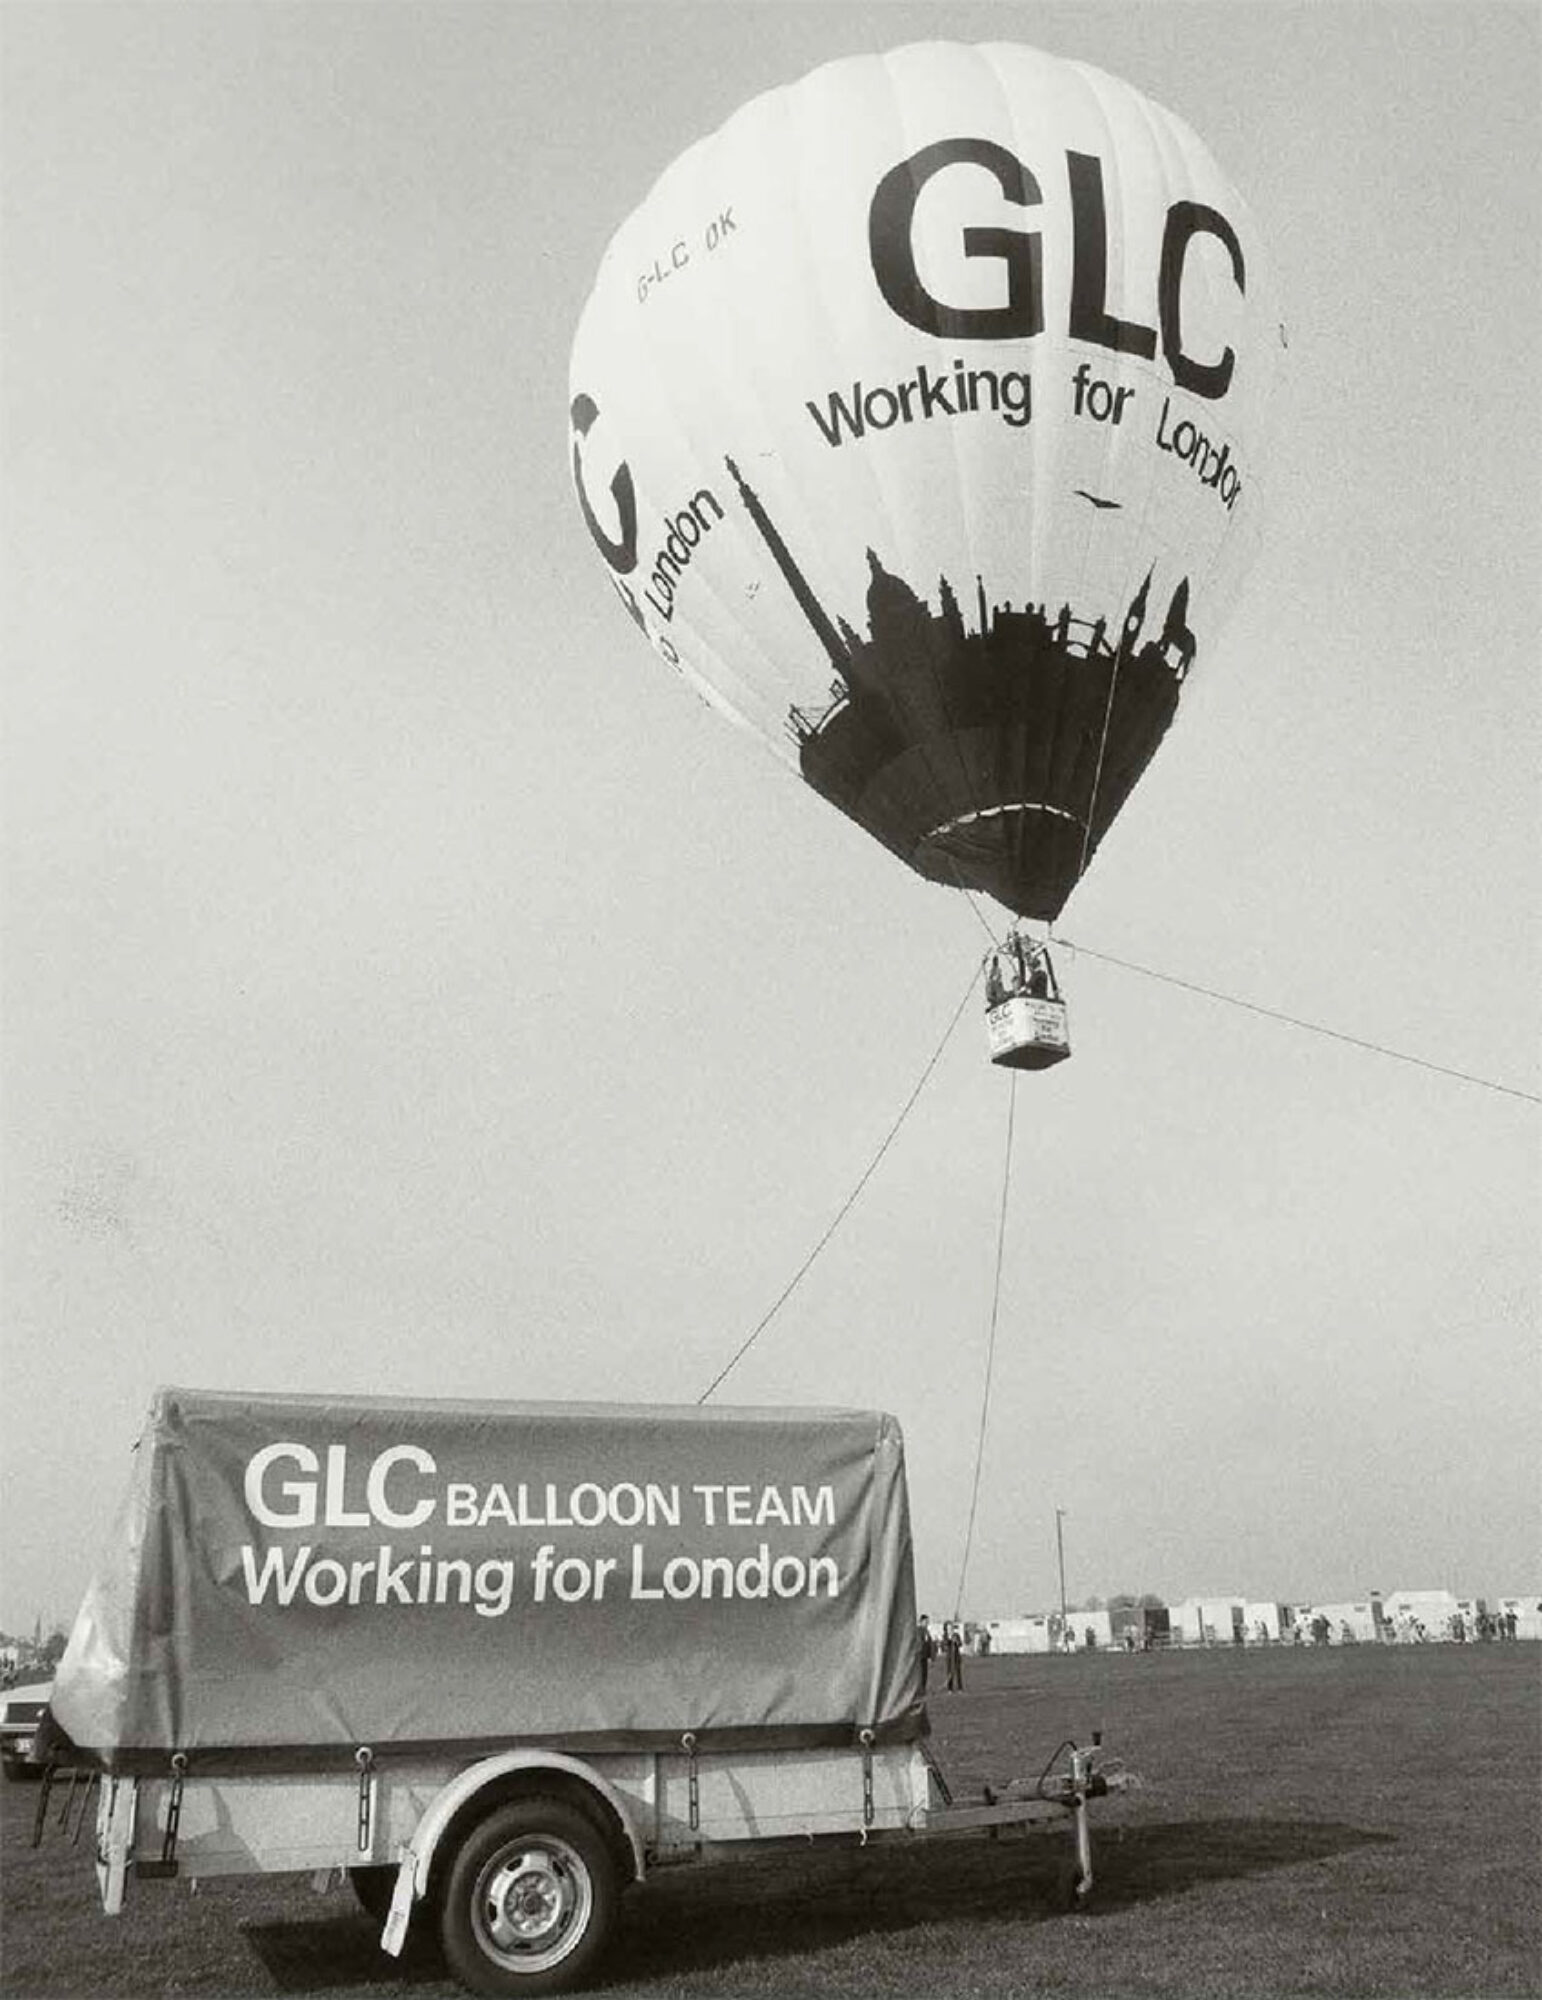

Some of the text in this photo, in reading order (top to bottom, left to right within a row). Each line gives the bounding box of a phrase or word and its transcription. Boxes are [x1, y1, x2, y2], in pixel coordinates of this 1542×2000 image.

[868, 137, 1245, 400] GLC
[805, 359, 1032, 448] Working
[1071, 363, 1136, 426] for
[644, 489, 725, 623] London
[243, 1442, 837, 1530] GLC BALLOON TEAM
[240, 1543, 840, 1618] Working for London
